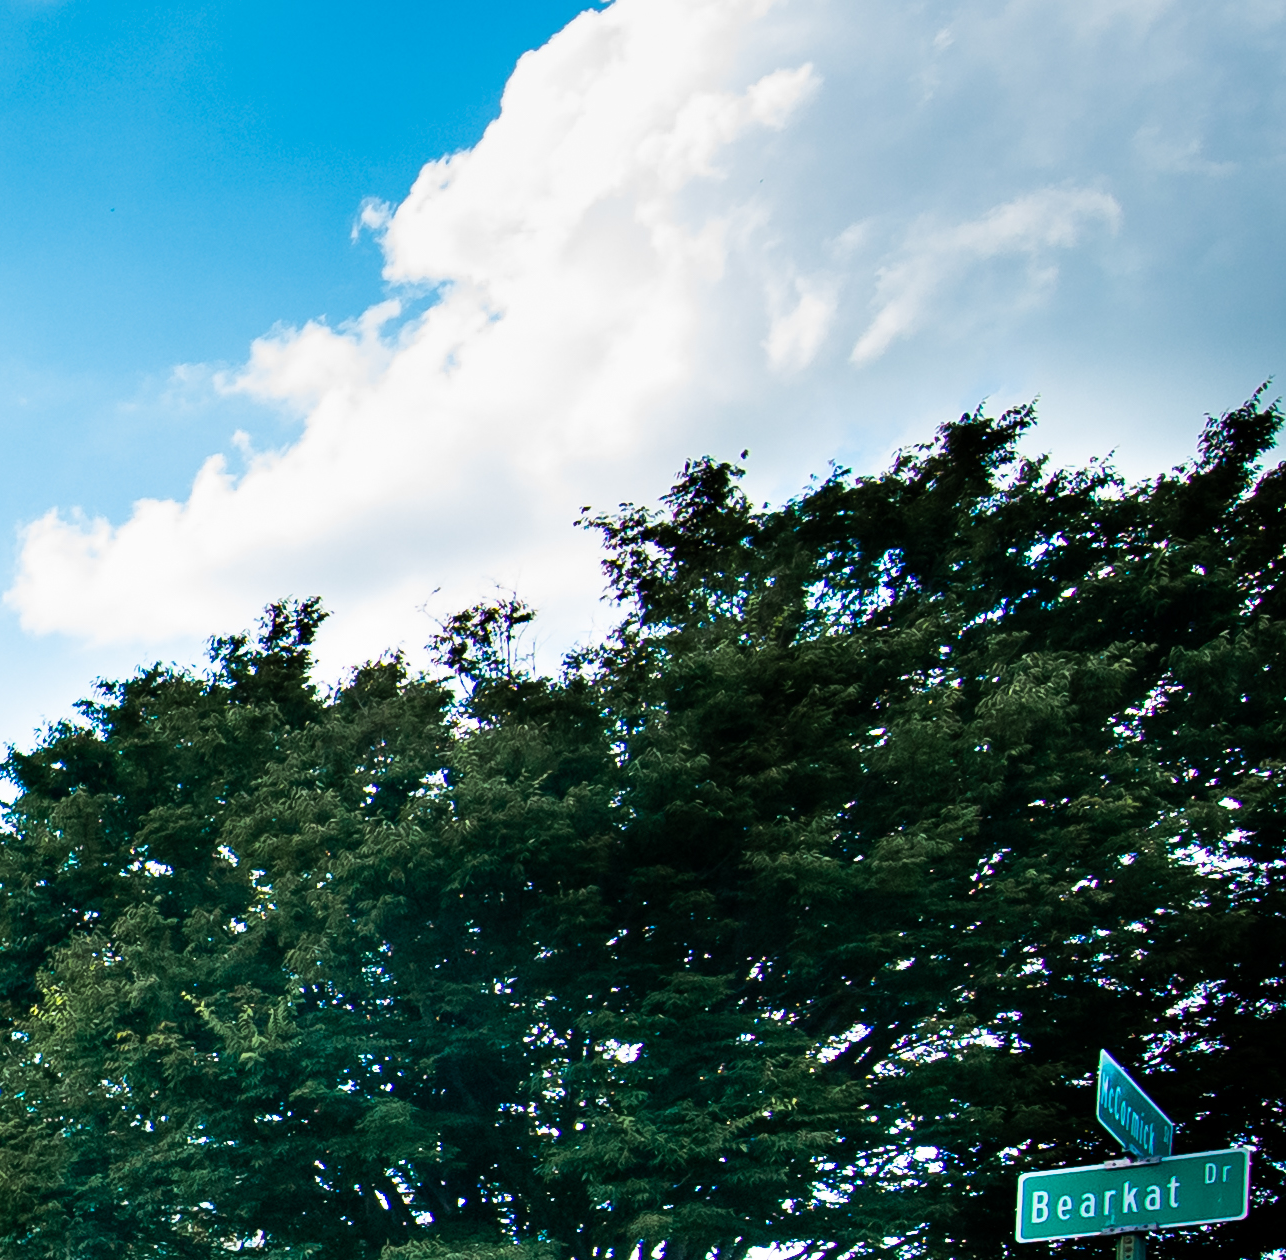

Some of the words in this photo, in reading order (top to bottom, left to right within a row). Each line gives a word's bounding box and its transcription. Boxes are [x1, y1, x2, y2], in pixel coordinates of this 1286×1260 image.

[1100, 1071, 1155, 1156] McCormick
[1031, 1175, 1181, 1224] Bearkat
[1204, 1162, 1232, 1185] Dr
